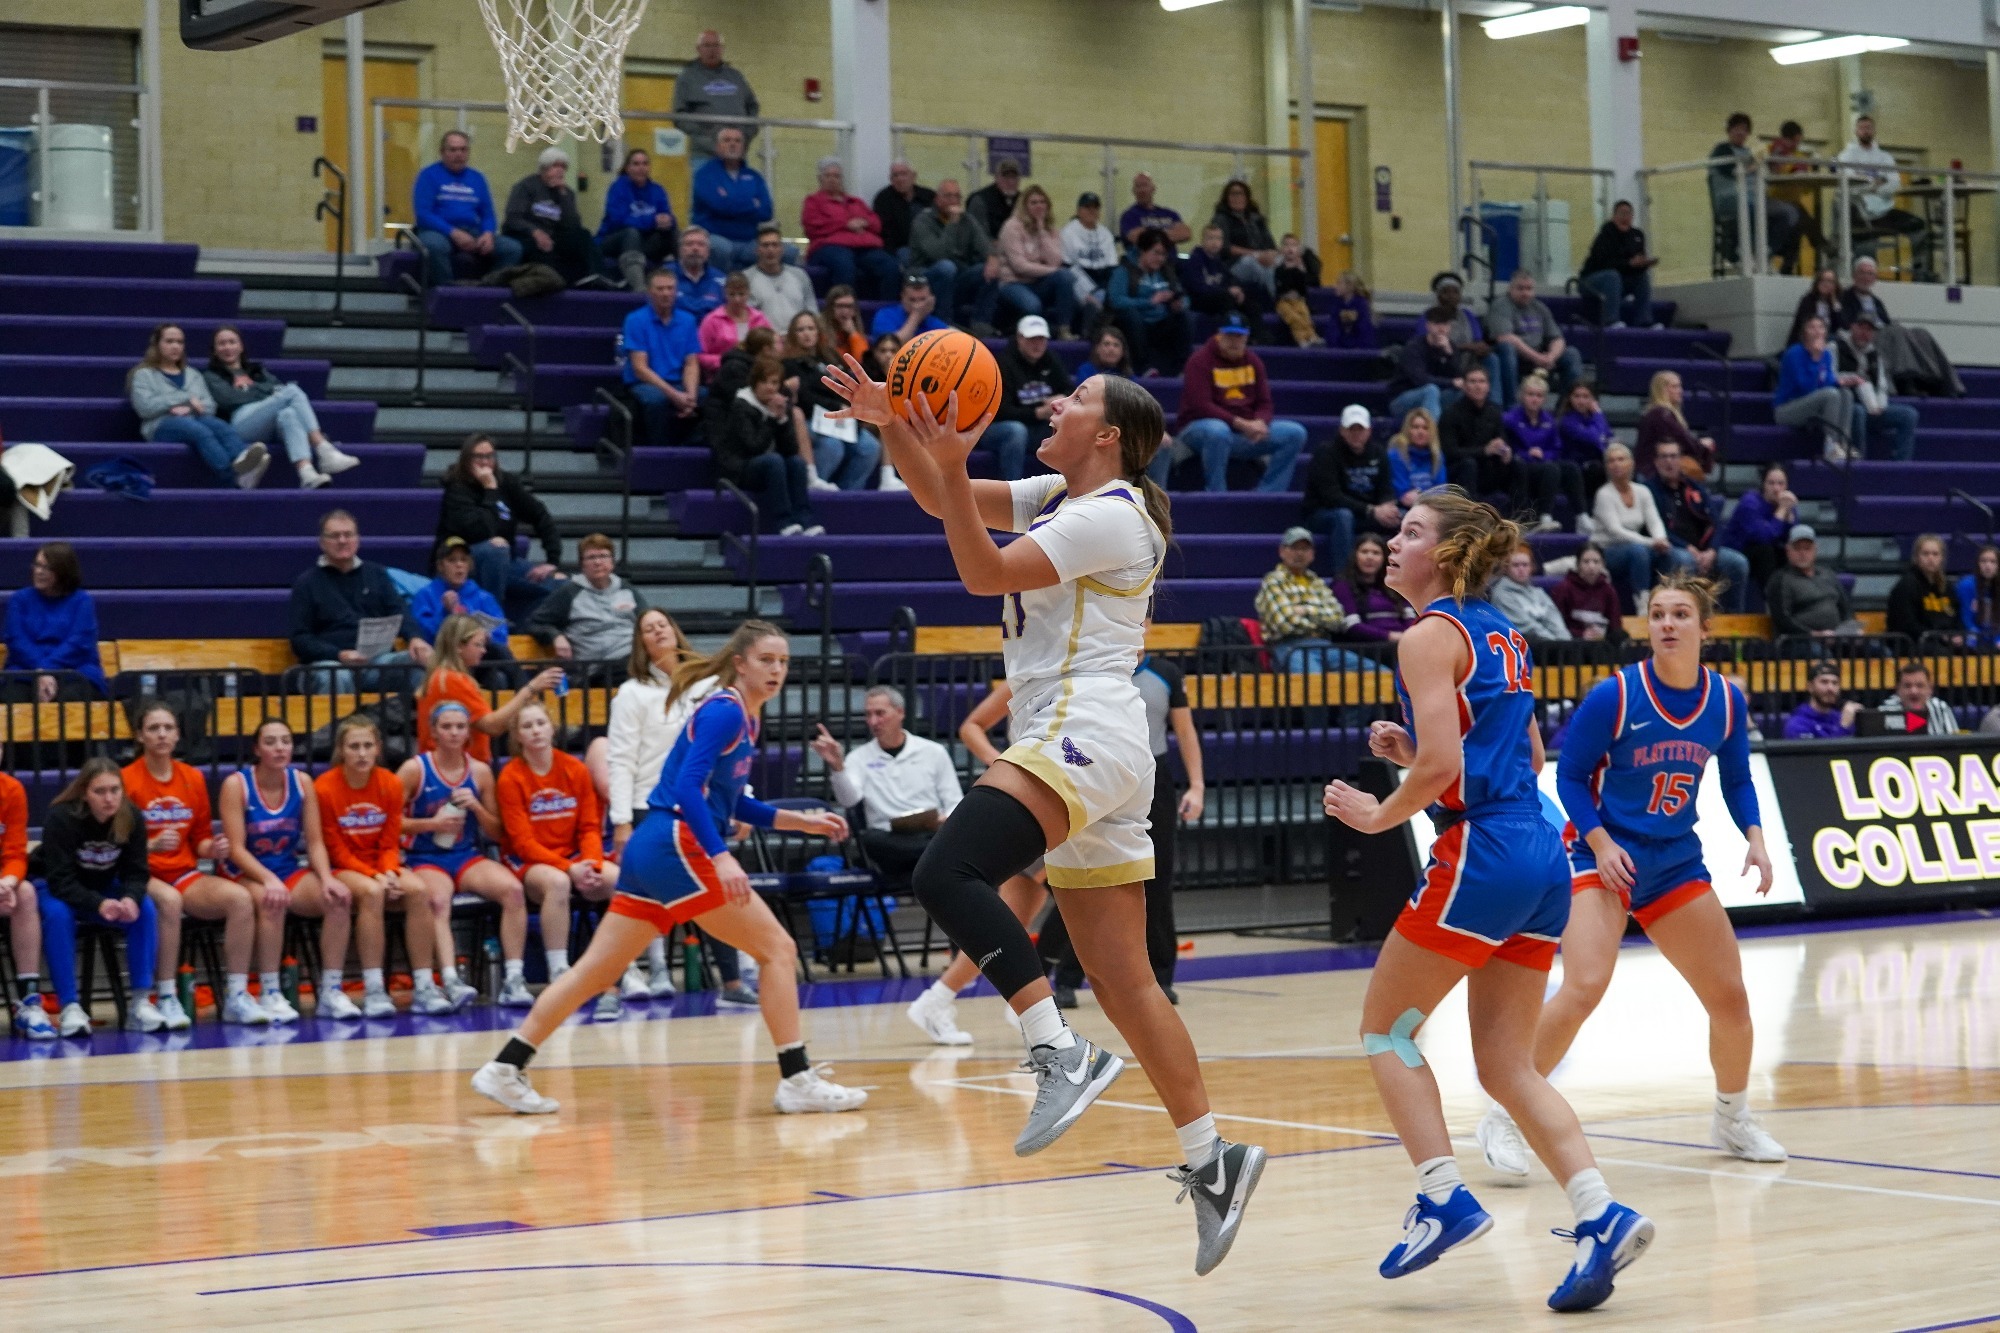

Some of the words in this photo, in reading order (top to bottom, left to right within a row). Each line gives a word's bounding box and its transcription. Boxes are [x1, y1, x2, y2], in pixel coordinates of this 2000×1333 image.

[1646, 771, 1695, 816] 15
[1829, 753, 2000, 821] LORA
[1812, 818, 2000, 890] COLLE
